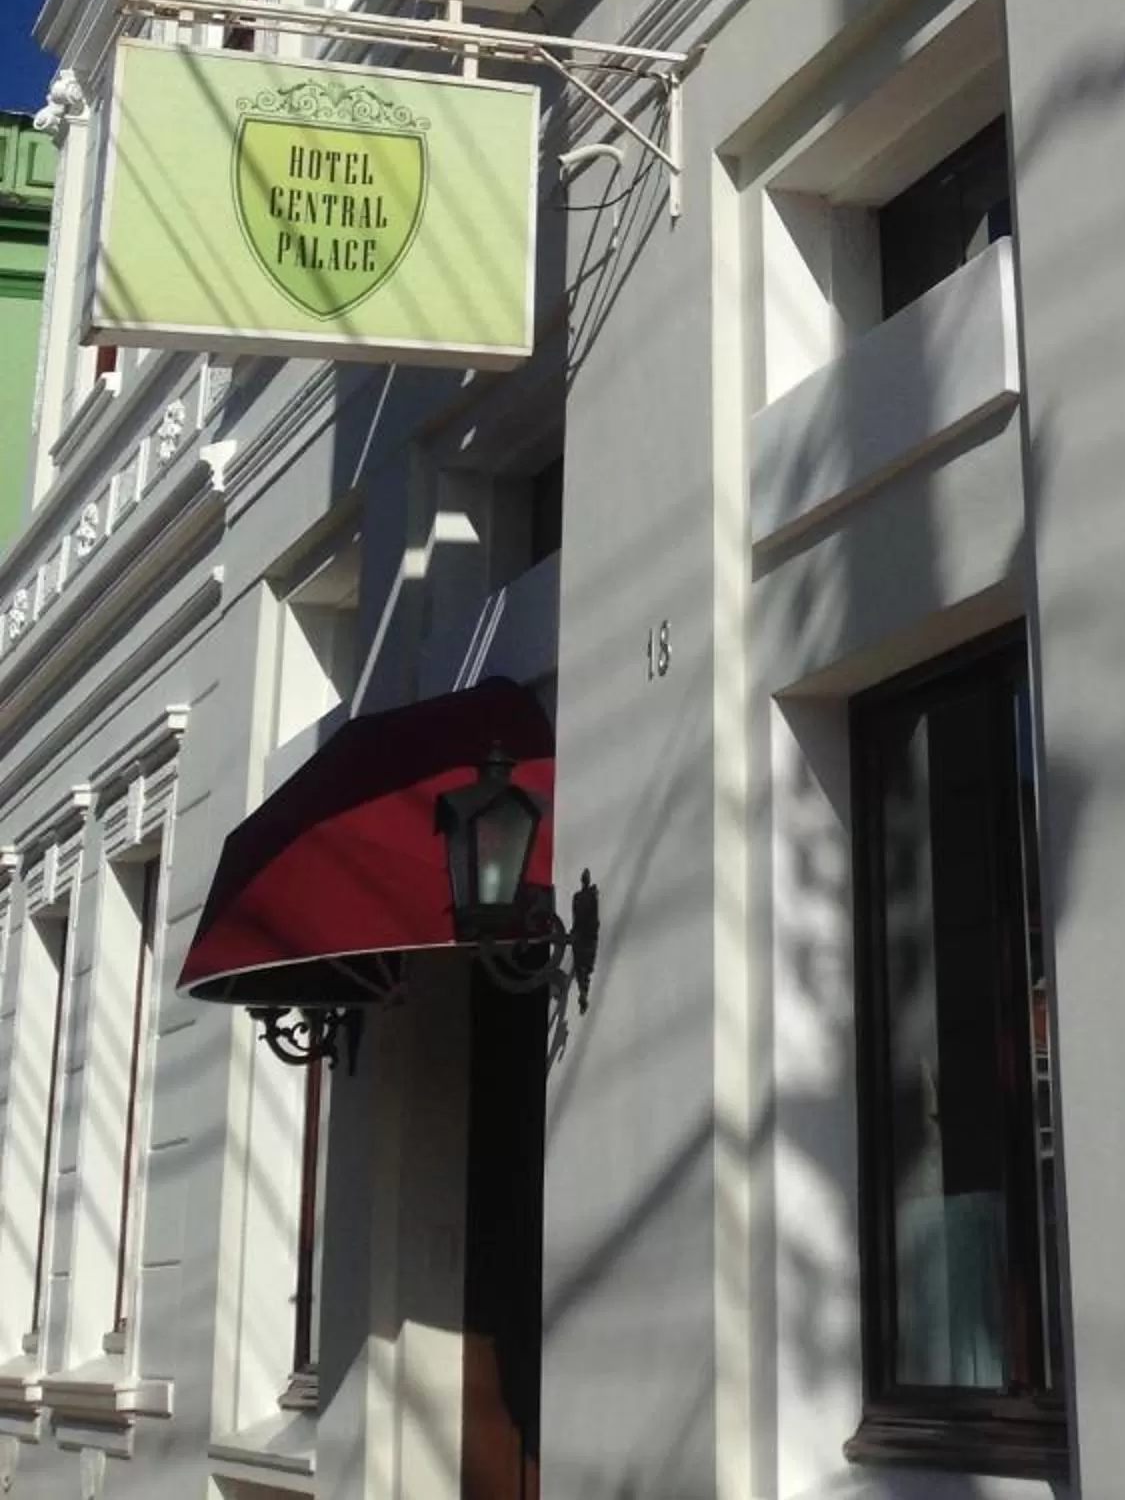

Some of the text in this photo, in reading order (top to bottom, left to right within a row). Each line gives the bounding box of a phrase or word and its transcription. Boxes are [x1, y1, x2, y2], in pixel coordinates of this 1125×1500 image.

[289, 145, 373, 185] HOTEL
[270, 186, 388, 228] CENTRAL
[277, 231, 376, 272] PALACE
